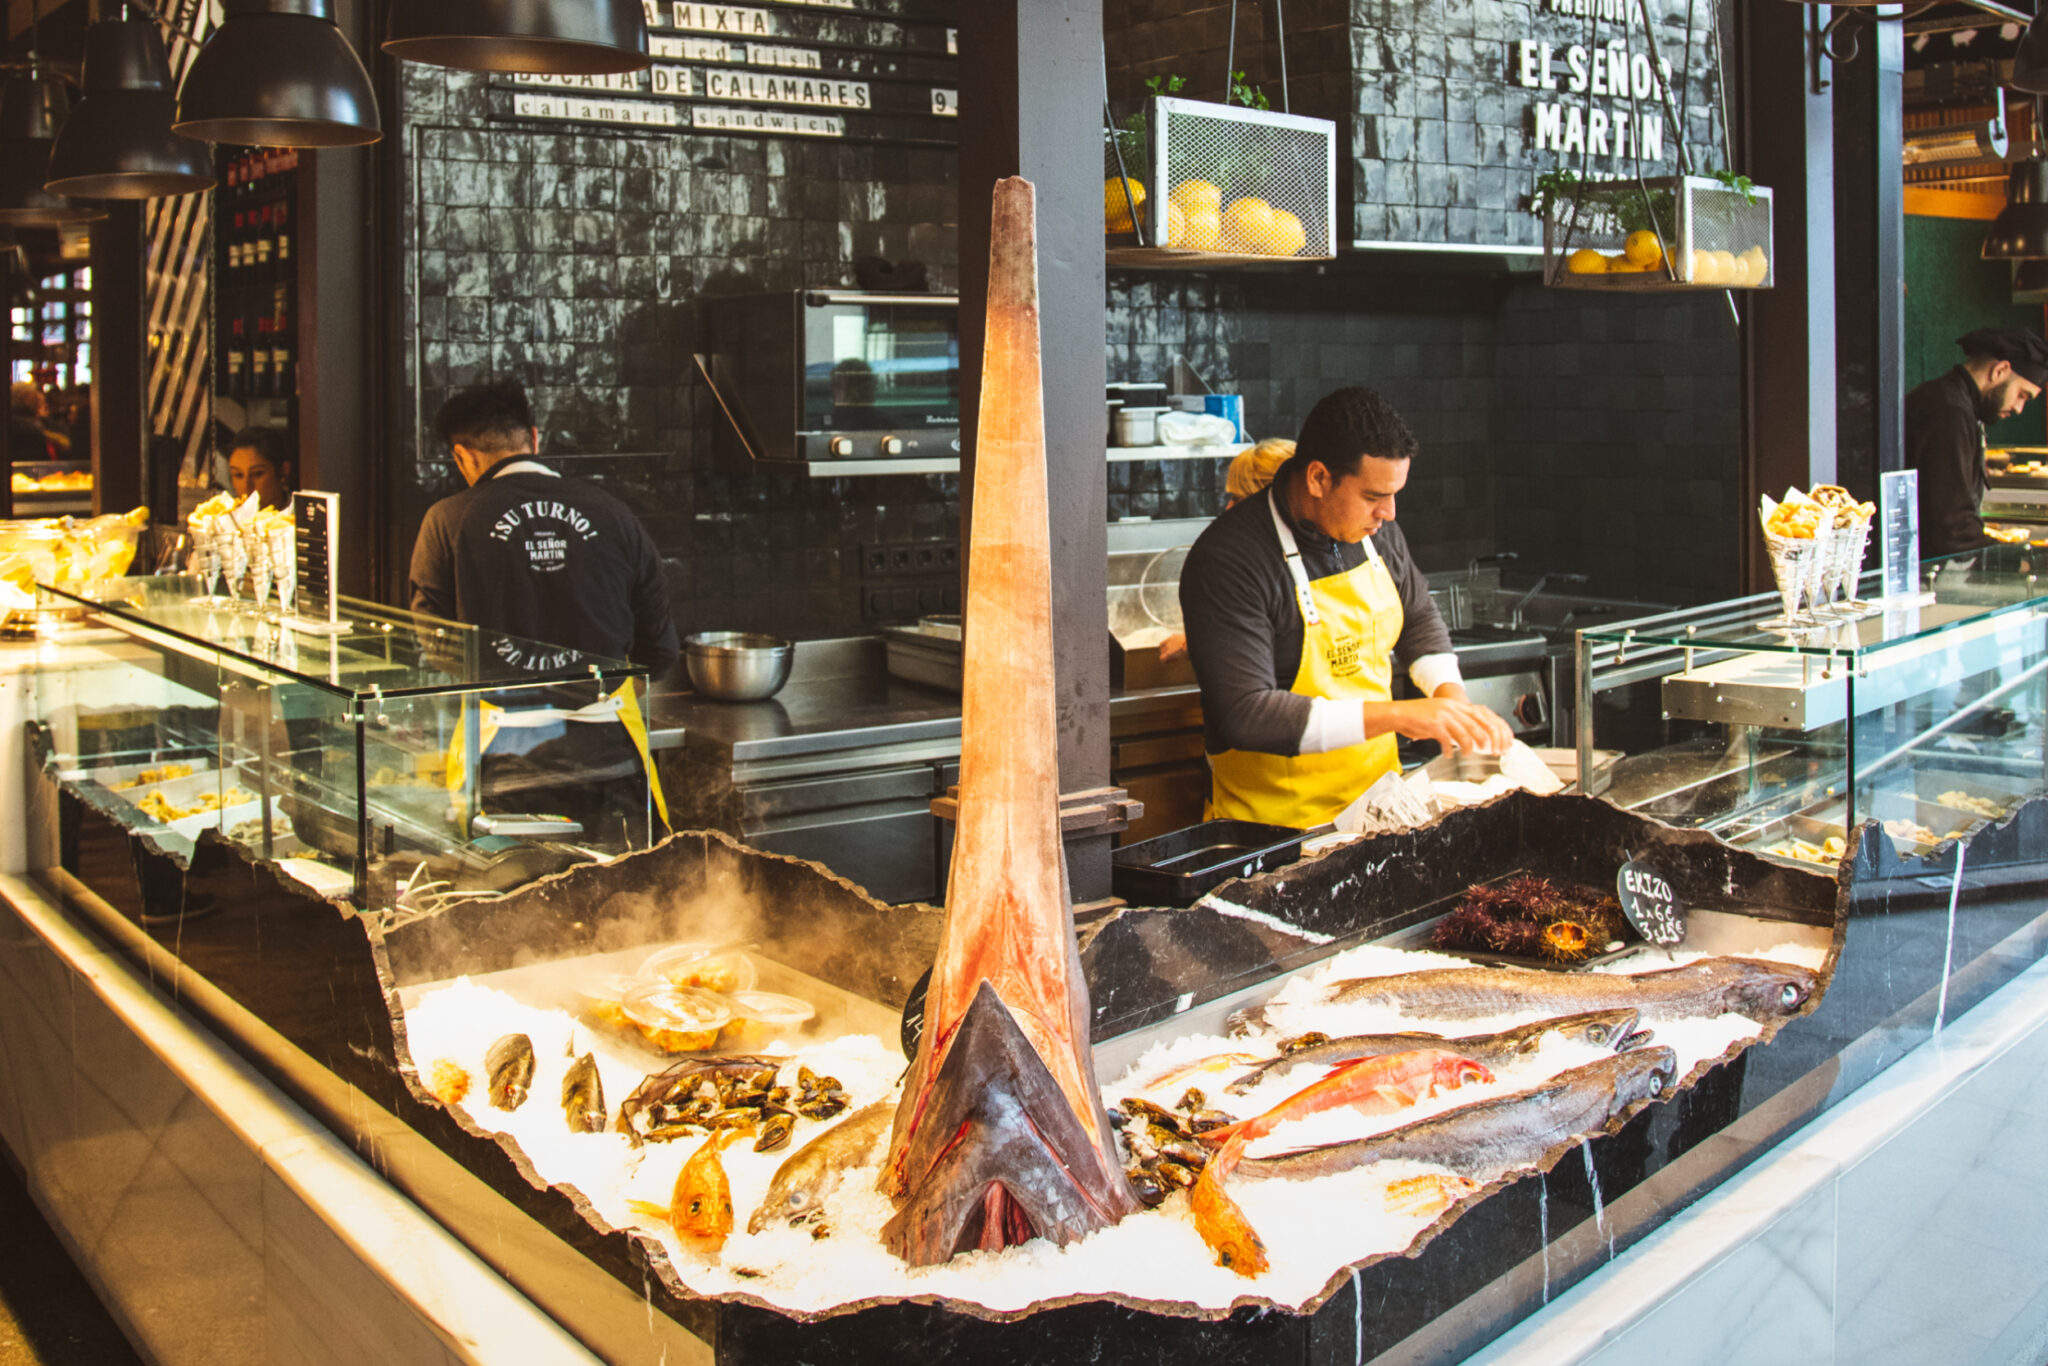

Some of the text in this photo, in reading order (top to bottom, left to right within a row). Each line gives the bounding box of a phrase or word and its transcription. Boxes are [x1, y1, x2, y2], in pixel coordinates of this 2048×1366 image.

[676, 5, 766, 33] MIXTA
[753, 46, 820, 69] fish
[1520, 39, 1557, 90] EL
[655, 70, 687, 92] DE
[710, 74, 867, 106] CALAMARES
[521, 99, 836, 133] calamari sandwich
[1536, 102, 1662, 161] MARTIN
[489, 501, 598, 541] ¡SU TURNO!
[525, 537, 567, 551] EL SEÑOR
[530, 550, 565, 561] MARTIN
